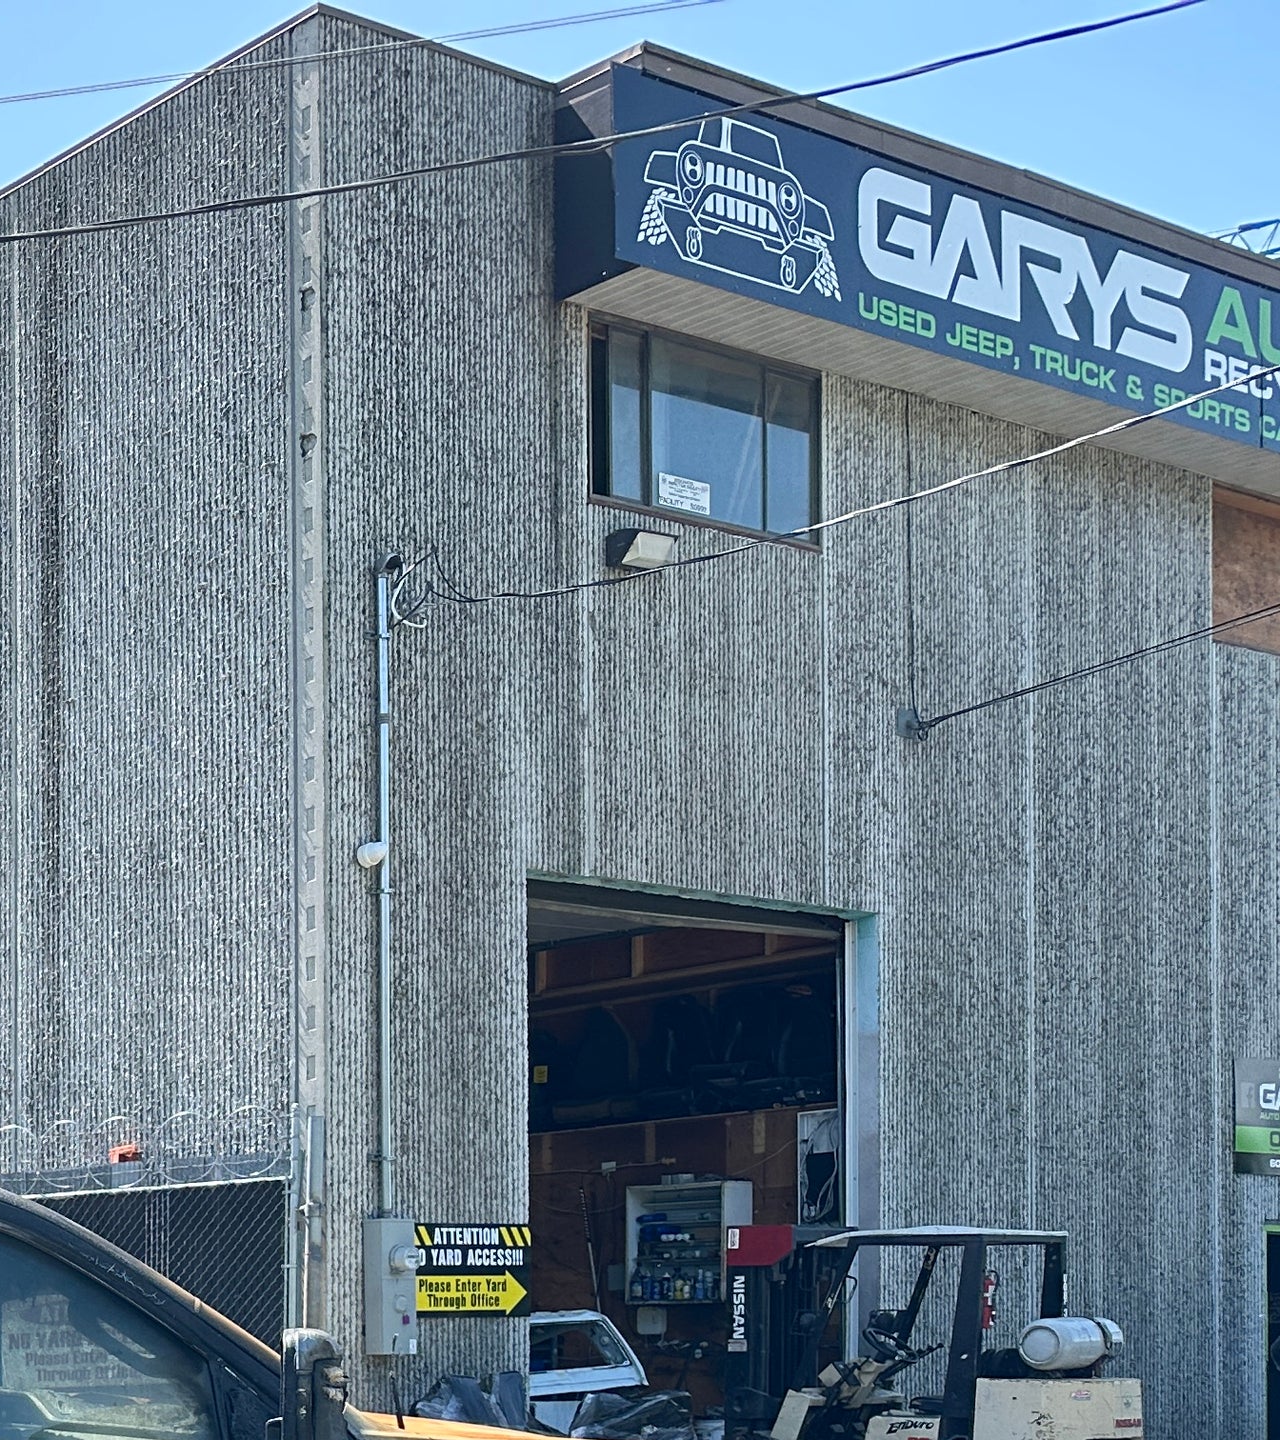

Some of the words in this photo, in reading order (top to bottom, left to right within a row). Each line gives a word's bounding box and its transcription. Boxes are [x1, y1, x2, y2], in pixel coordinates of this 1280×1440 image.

[858, 167, 1193, 373] GARYS
[858, 292, 936, 339] USED
[946, 322, 1021, 370] JEEP,
[1029, 343, 1117, 393] TRUCK
[1126, 374, 1144, 401] &
[1154, 383, 1251, 432] SPORTS
[1204, 348, 1280, 400] REC
[433, 1227, 500, 1246] ATTENTION
[431, 1249, 462, 1266] YARD
[467, 1249, 524, 1266] ACCESS!!!
[419, 1278, 451, 1292] Please
[455, 1279, 481, 1292] Enter
[485, 1278, 507, 1292] Yard
[427, 1294, 469, 1309] Through
[470, 1294, 500, 1307] Office
[732, 1275, 745, 1339] NISSAN
